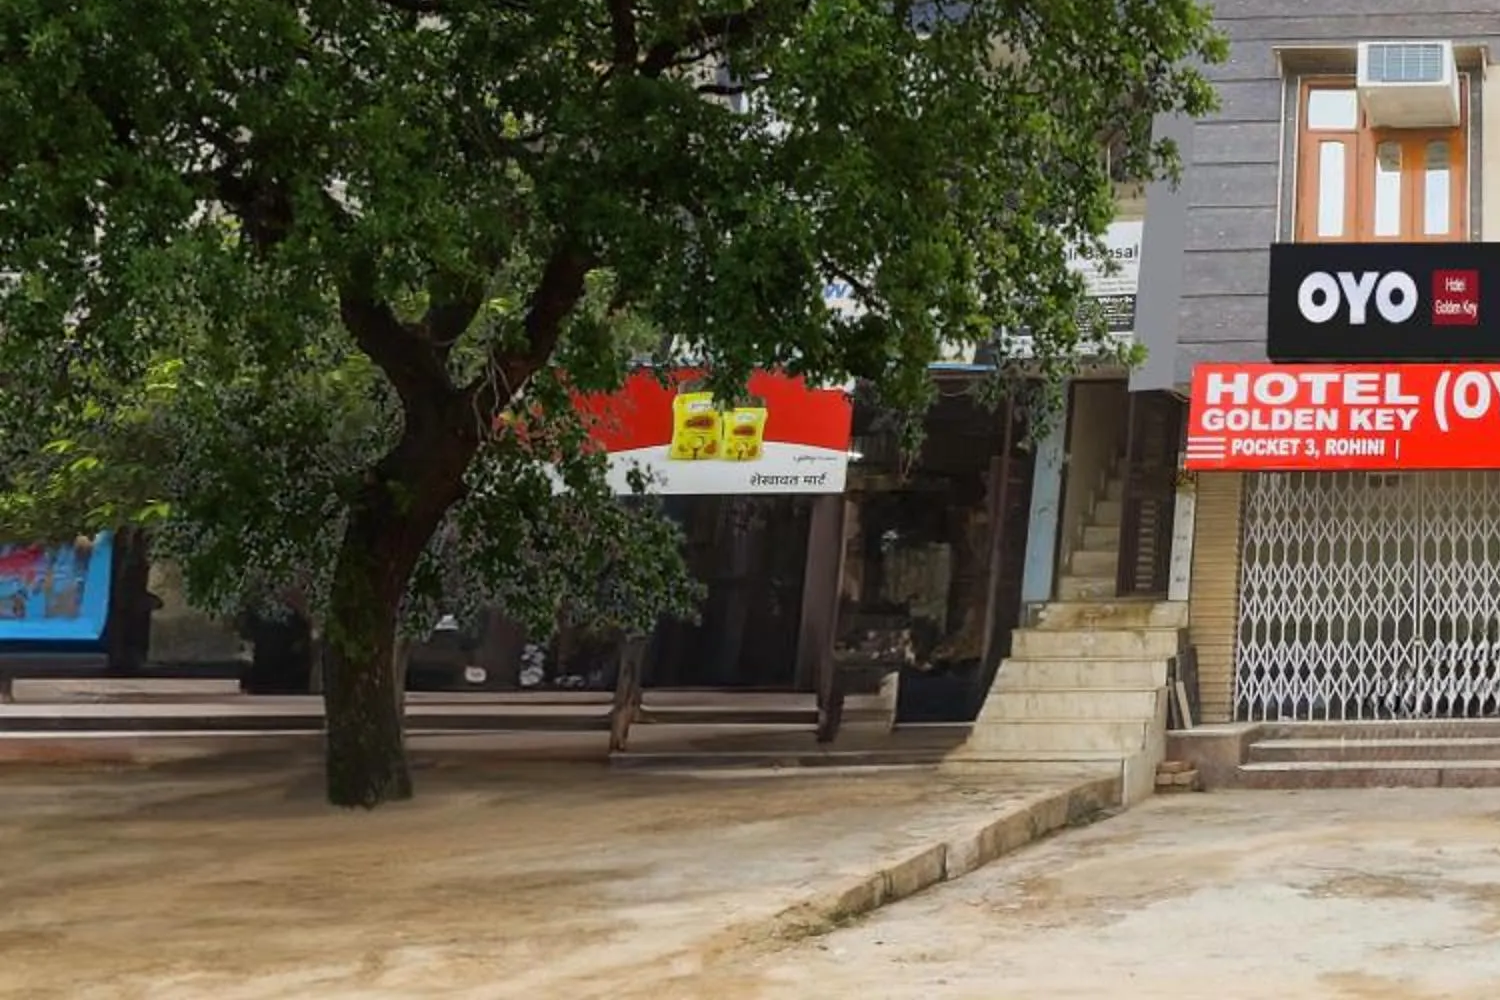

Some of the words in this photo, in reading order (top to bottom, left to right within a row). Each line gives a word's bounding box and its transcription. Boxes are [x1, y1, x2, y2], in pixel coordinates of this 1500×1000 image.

[1445, 277, 1466, 292] Hotel
[1298, 271, 1418, 324] OYO
[1463, 300, 1477, 318] Key
[1206, 372, 1420, 405] HOTEL
[1202, 408, 1339, 431] GOLDEN
[1350, 408, 1419, 431] KEY
[1231, 438, 1300, 456] POCKET
[1304, 438, 1320, 459] 3,
[1325, 438, 1385, 456] ROHINI
